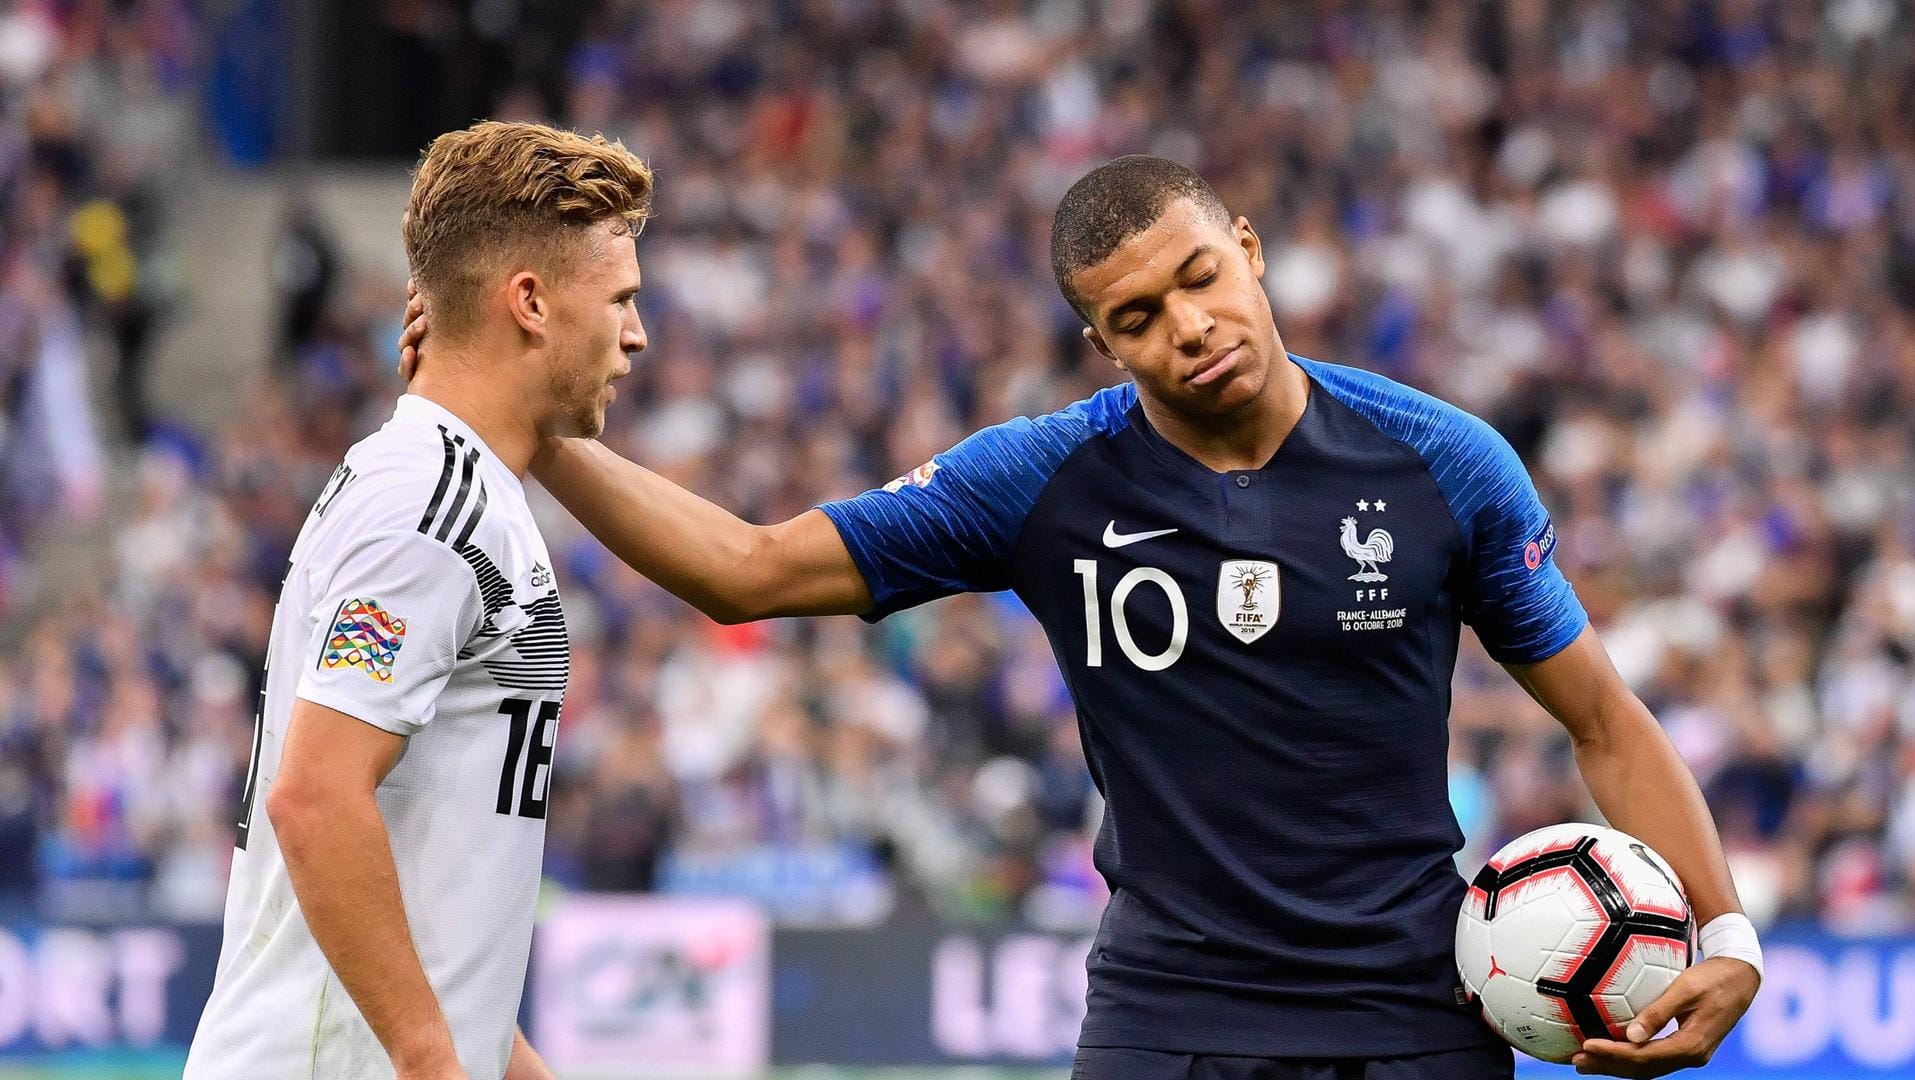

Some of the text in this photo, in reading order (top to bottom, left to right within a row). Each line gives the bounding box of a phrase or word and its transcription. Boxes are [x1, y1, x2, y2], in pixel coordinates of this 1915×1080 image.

[1073, 558, 1189, 671] 10
[1236, 613, 1261, 622] FIFA
[1342, 618, 1403, 631] 16 OCTOBRE 2018
[496, 698, 561, 819] 18
